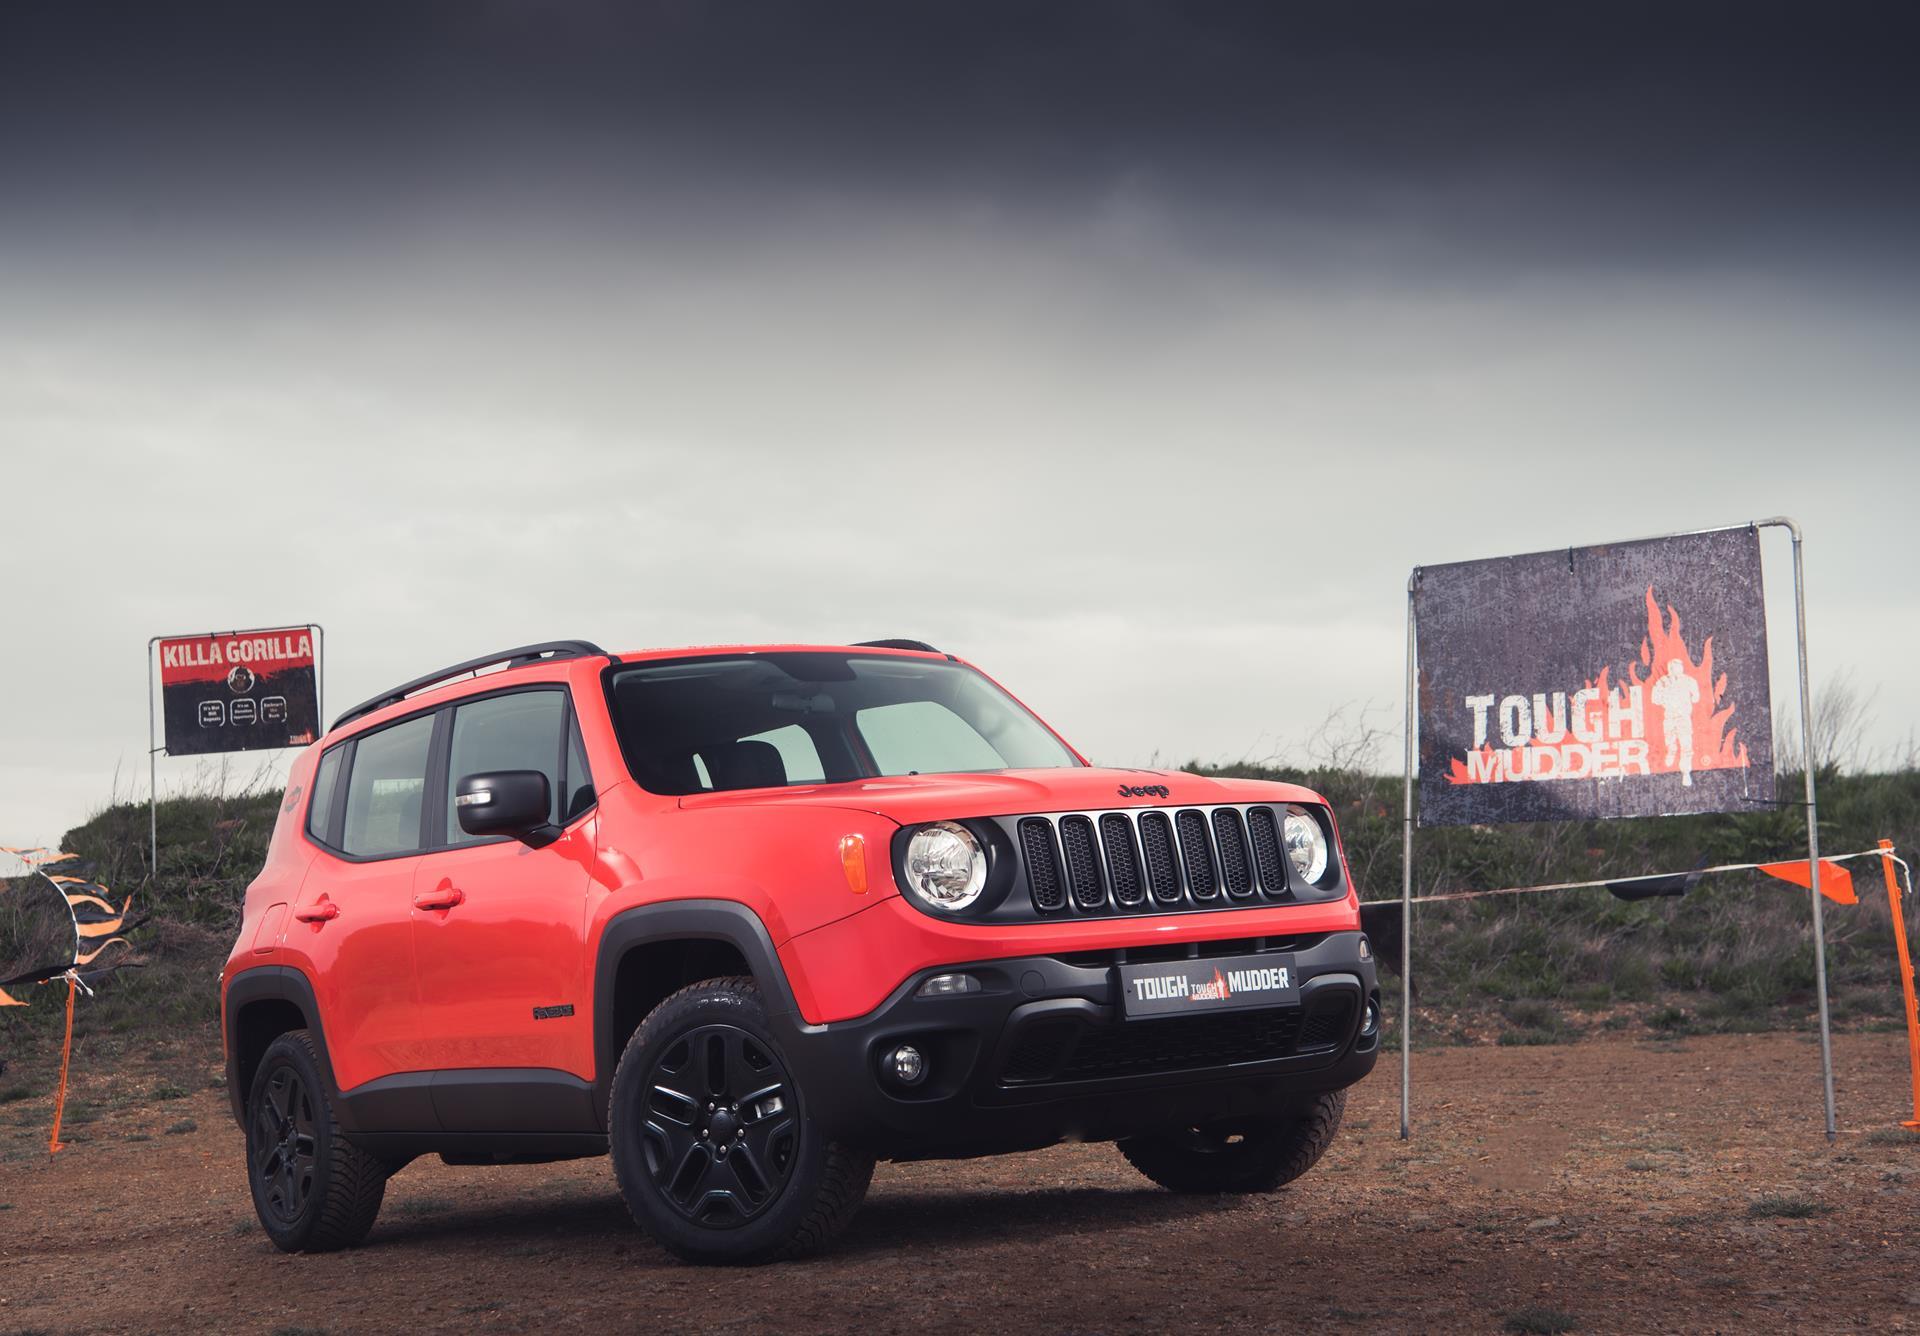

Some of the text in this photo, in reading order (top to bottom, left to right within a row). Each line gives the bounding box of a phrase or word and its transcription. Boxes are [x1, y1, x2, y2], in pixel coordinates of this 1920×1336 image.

[164, 635, 312, 668] KILLA GORILLA
[1465, 686, 1645, 751] TOUGH
[1465, 739, 1651, 784] MUDDER
[1117, 784, 1169, 799] Jeep
[1133, 967, 1290, 1001] TOUGH MUDDER
[1190, 982, 1217, 994] TOUGH
